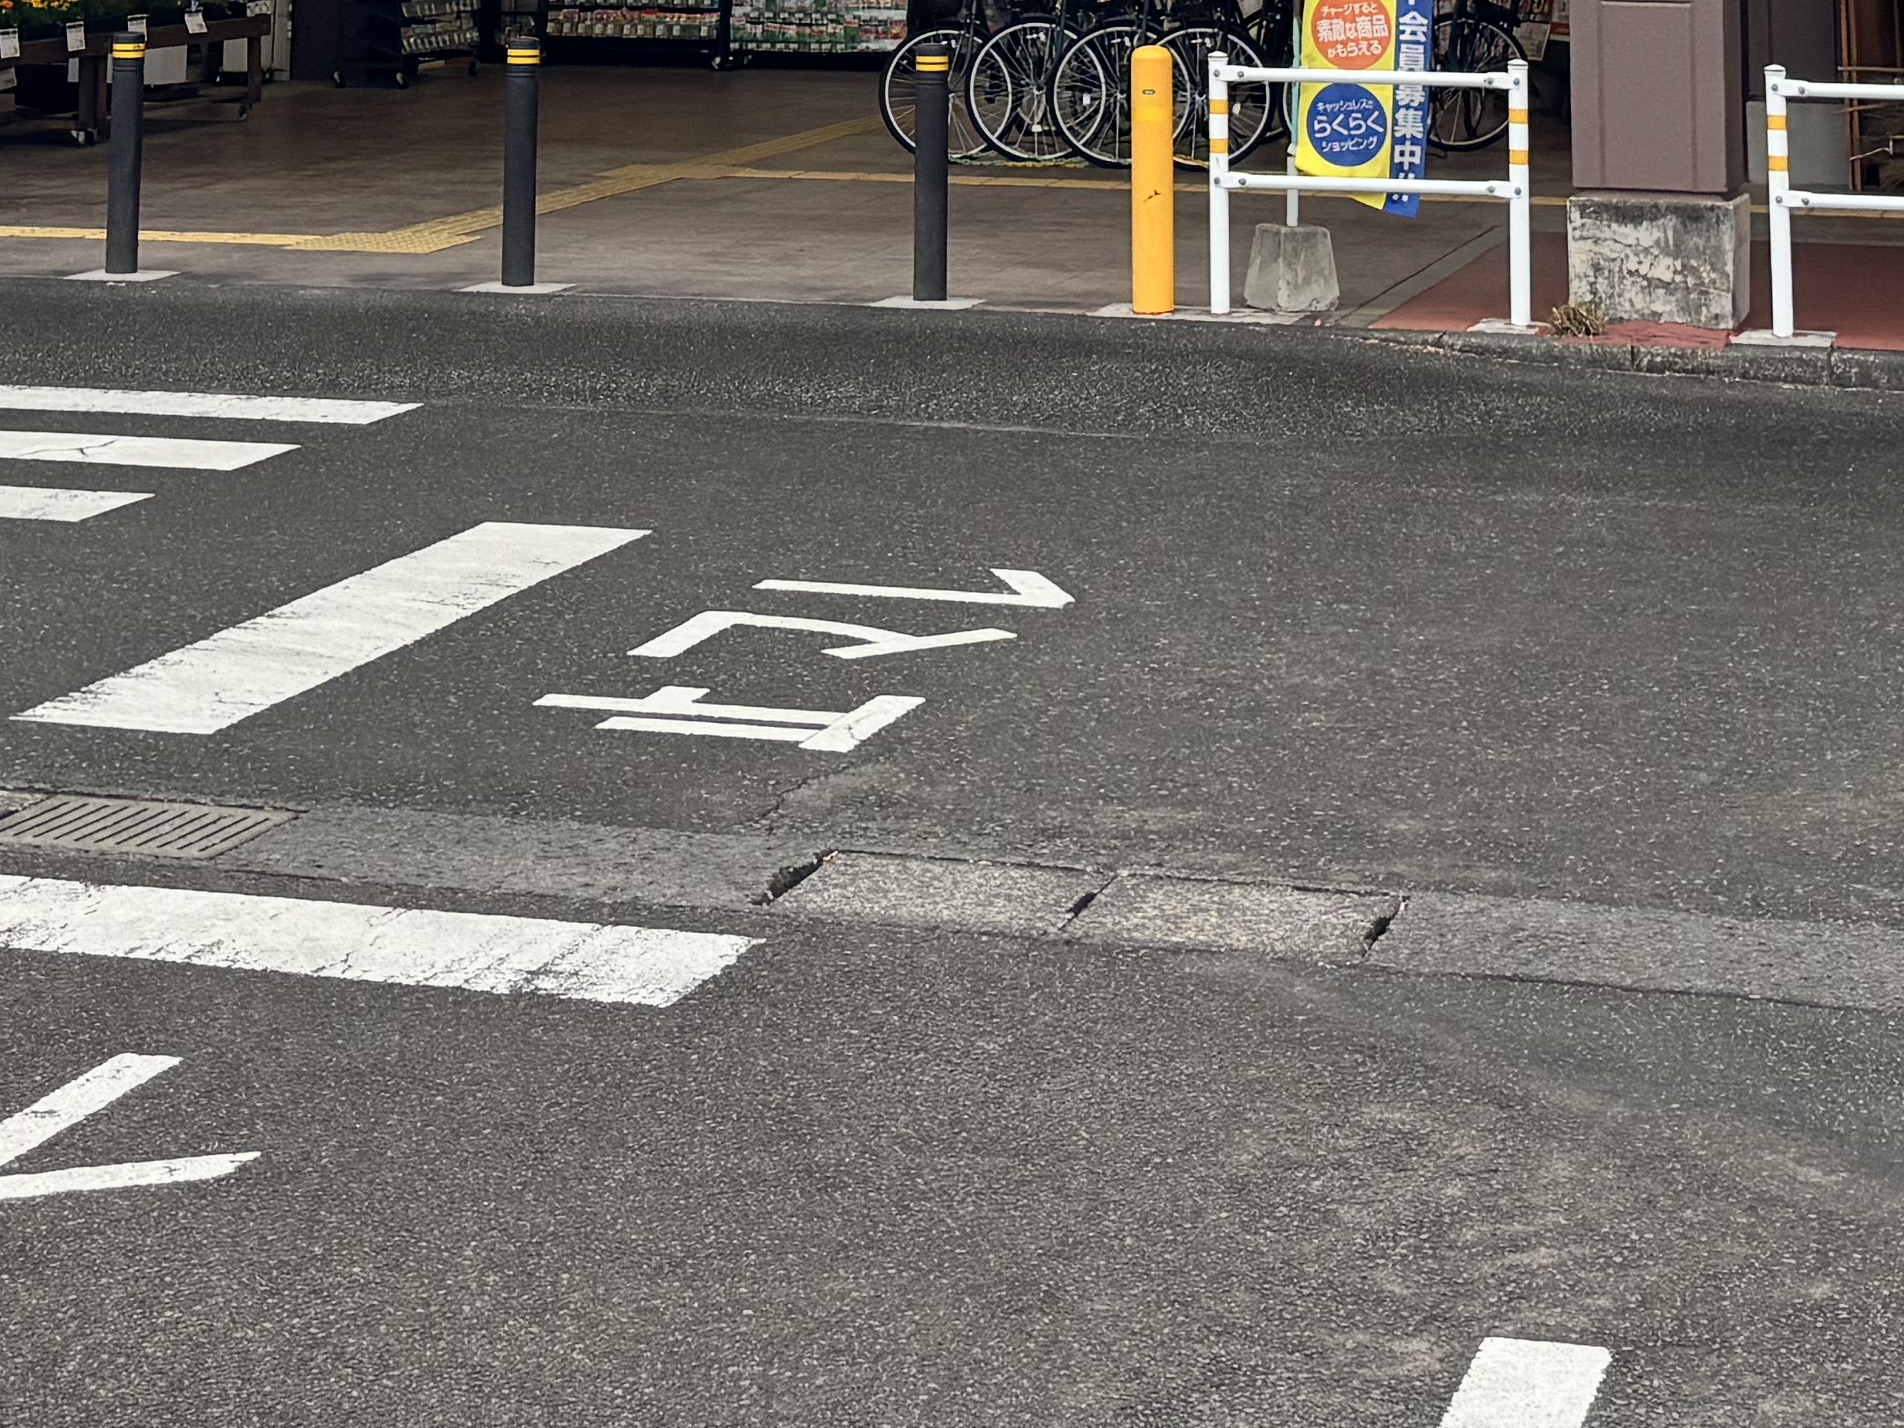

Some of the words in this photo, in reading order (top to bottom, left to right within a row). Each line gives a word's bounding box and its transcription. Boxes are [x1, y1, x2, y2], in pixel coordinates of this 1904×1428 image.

[1316, 14, 1390, 43] 素敵な商品
[1327, 40, 1383, 59] がもらえる
[1313, 110, 1385, 138] らくらく
